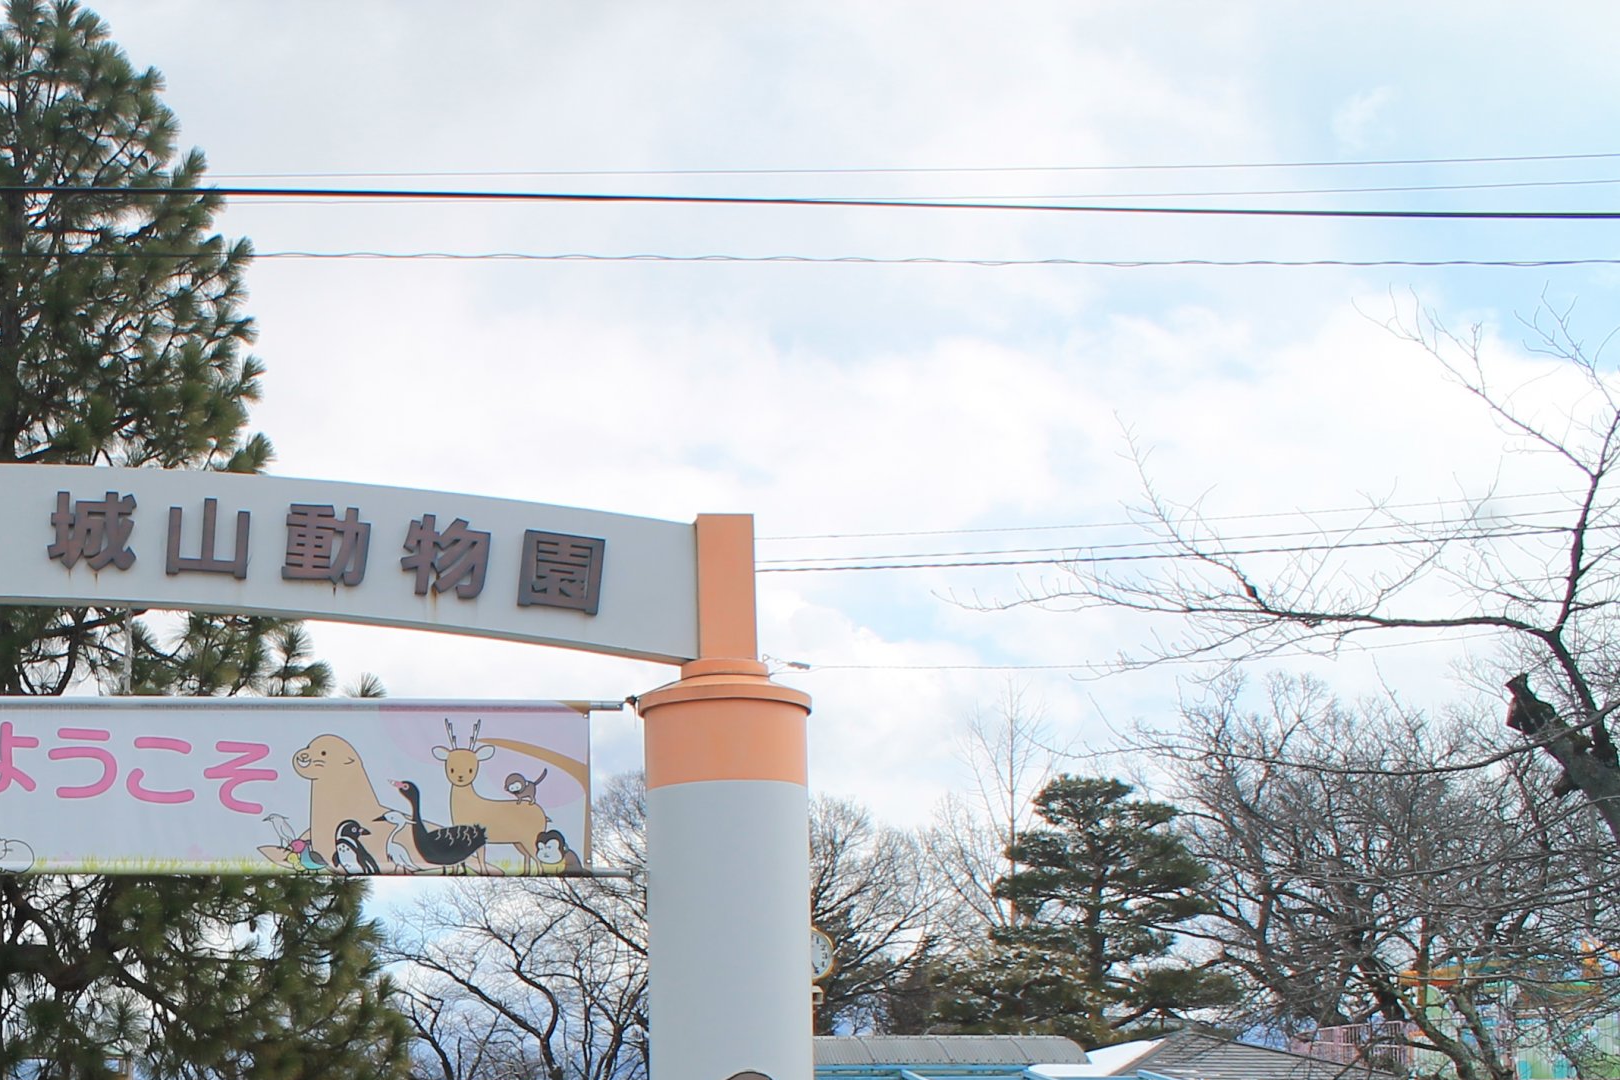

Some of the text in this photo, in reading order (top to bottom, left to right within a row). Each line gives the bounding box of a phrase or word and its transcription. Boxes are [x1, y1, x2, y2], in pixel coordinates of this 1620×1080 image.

[47, 490, 606, 616] 城山動物園
